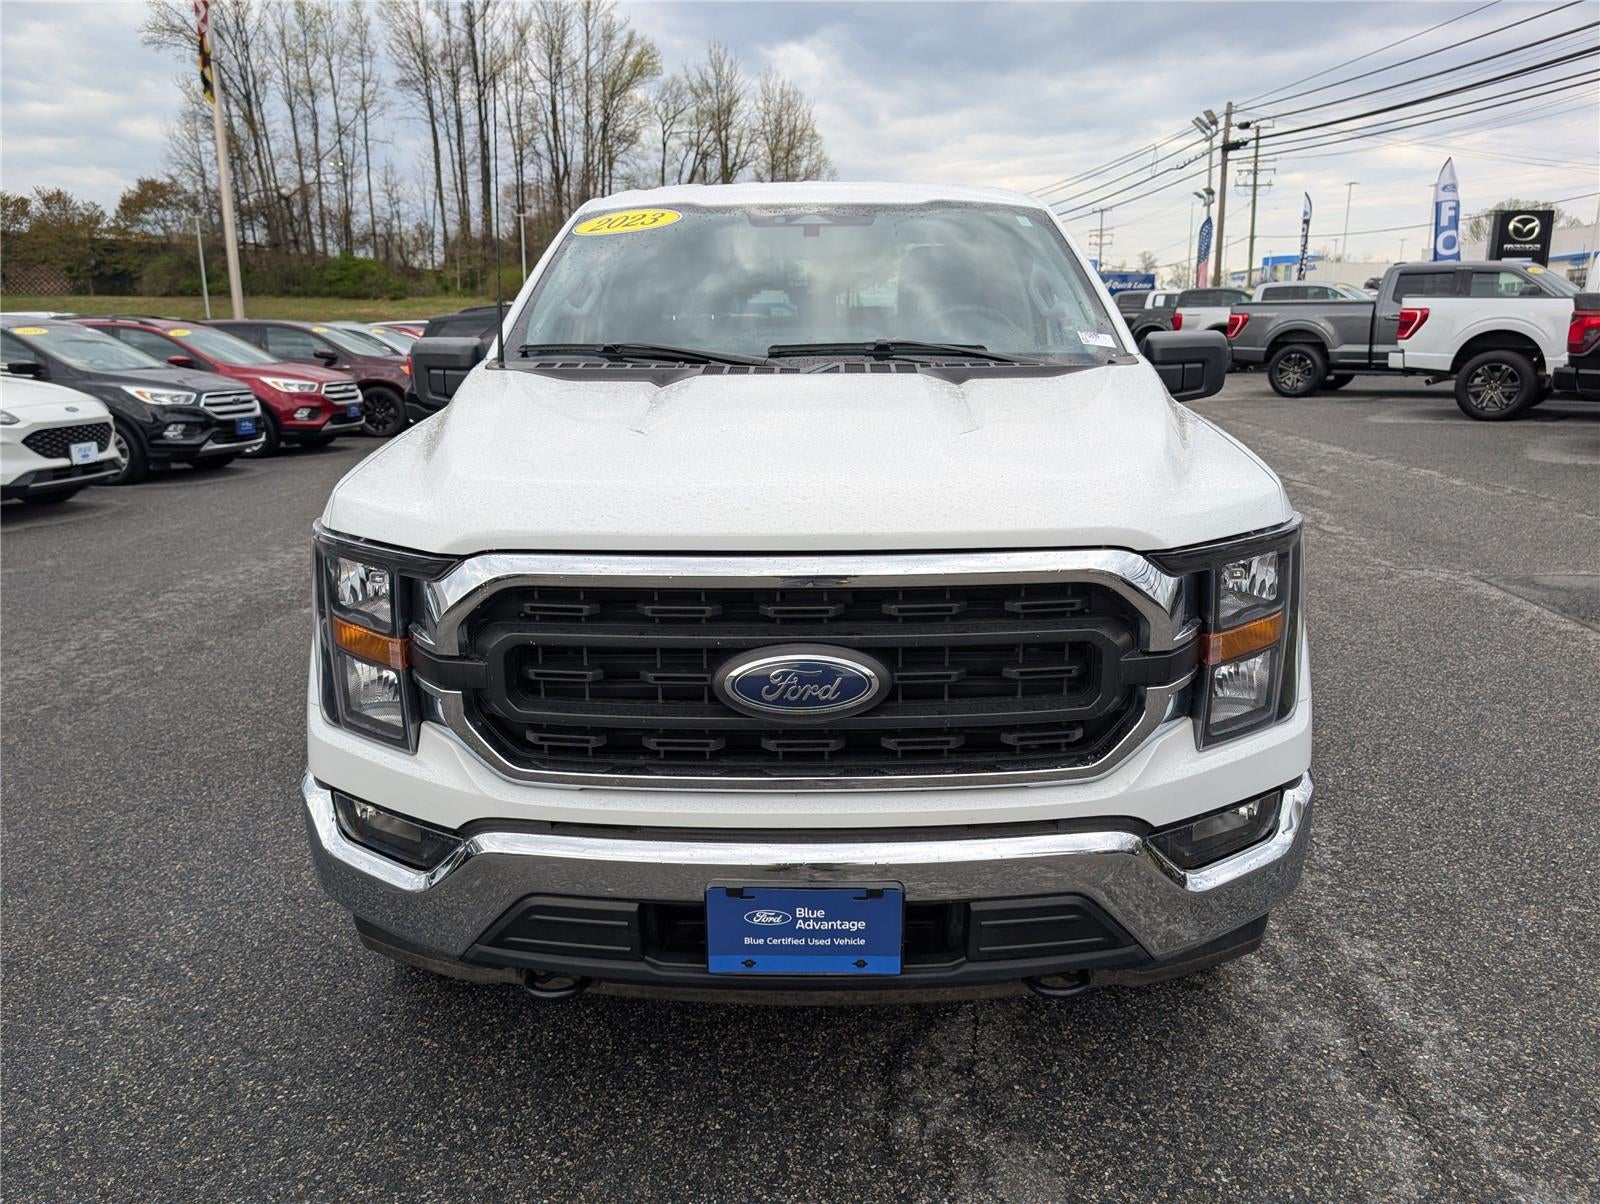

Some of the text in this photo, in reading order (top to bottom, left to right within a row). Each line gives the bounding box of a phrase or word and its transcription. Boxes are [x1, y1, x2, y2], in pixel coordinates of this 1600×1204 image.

[587, 212, 666, 232] 2023
[1436, 201, 1460, 262] FO
[1503, 243, 1541, 252] mazda
[1112, 281, 1152, 289] Quick Lane
[761, 668, 843, 701] Ford
[752, 911, 783, 924] Ford
[796, 907, 825, 918] Blue
[795, 919, 866, 932] Advantage
[743, 936, 866, 946] Blue Certified Used Vehicle
